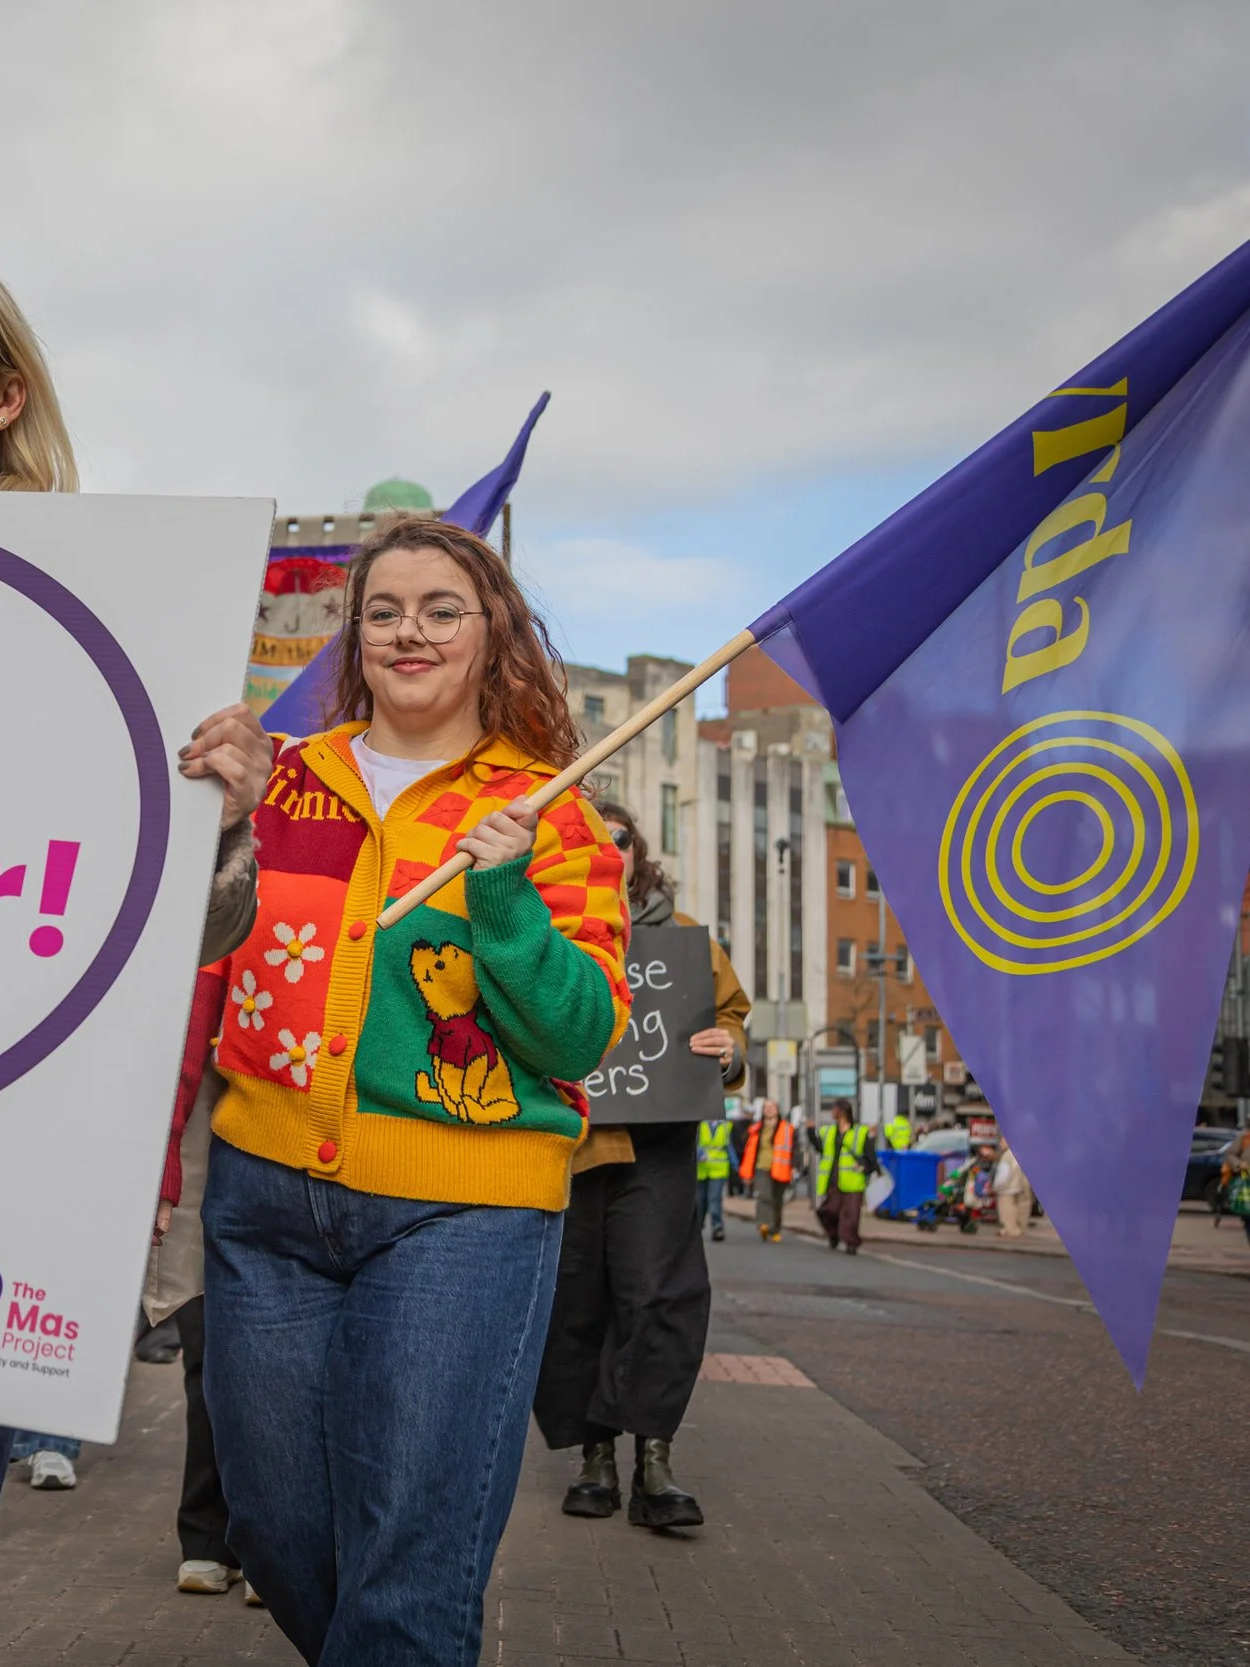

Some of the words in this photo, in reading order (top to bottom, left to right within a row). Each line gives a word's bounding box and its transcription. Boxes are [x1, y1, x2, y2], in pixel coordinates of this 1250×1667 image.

[626, 960, 673, 990] se
[618, 1009, 669, 1061] ng
[583, 1063, 649, 1097] ers
[12, 1281, 46, 1301] The
[5, 1301, 80, 1341] Mas
[1, 1332, 76, 1362] Project
[9, 1356, 29, 1371] and
[31, 1361, 70, 1378] Support
